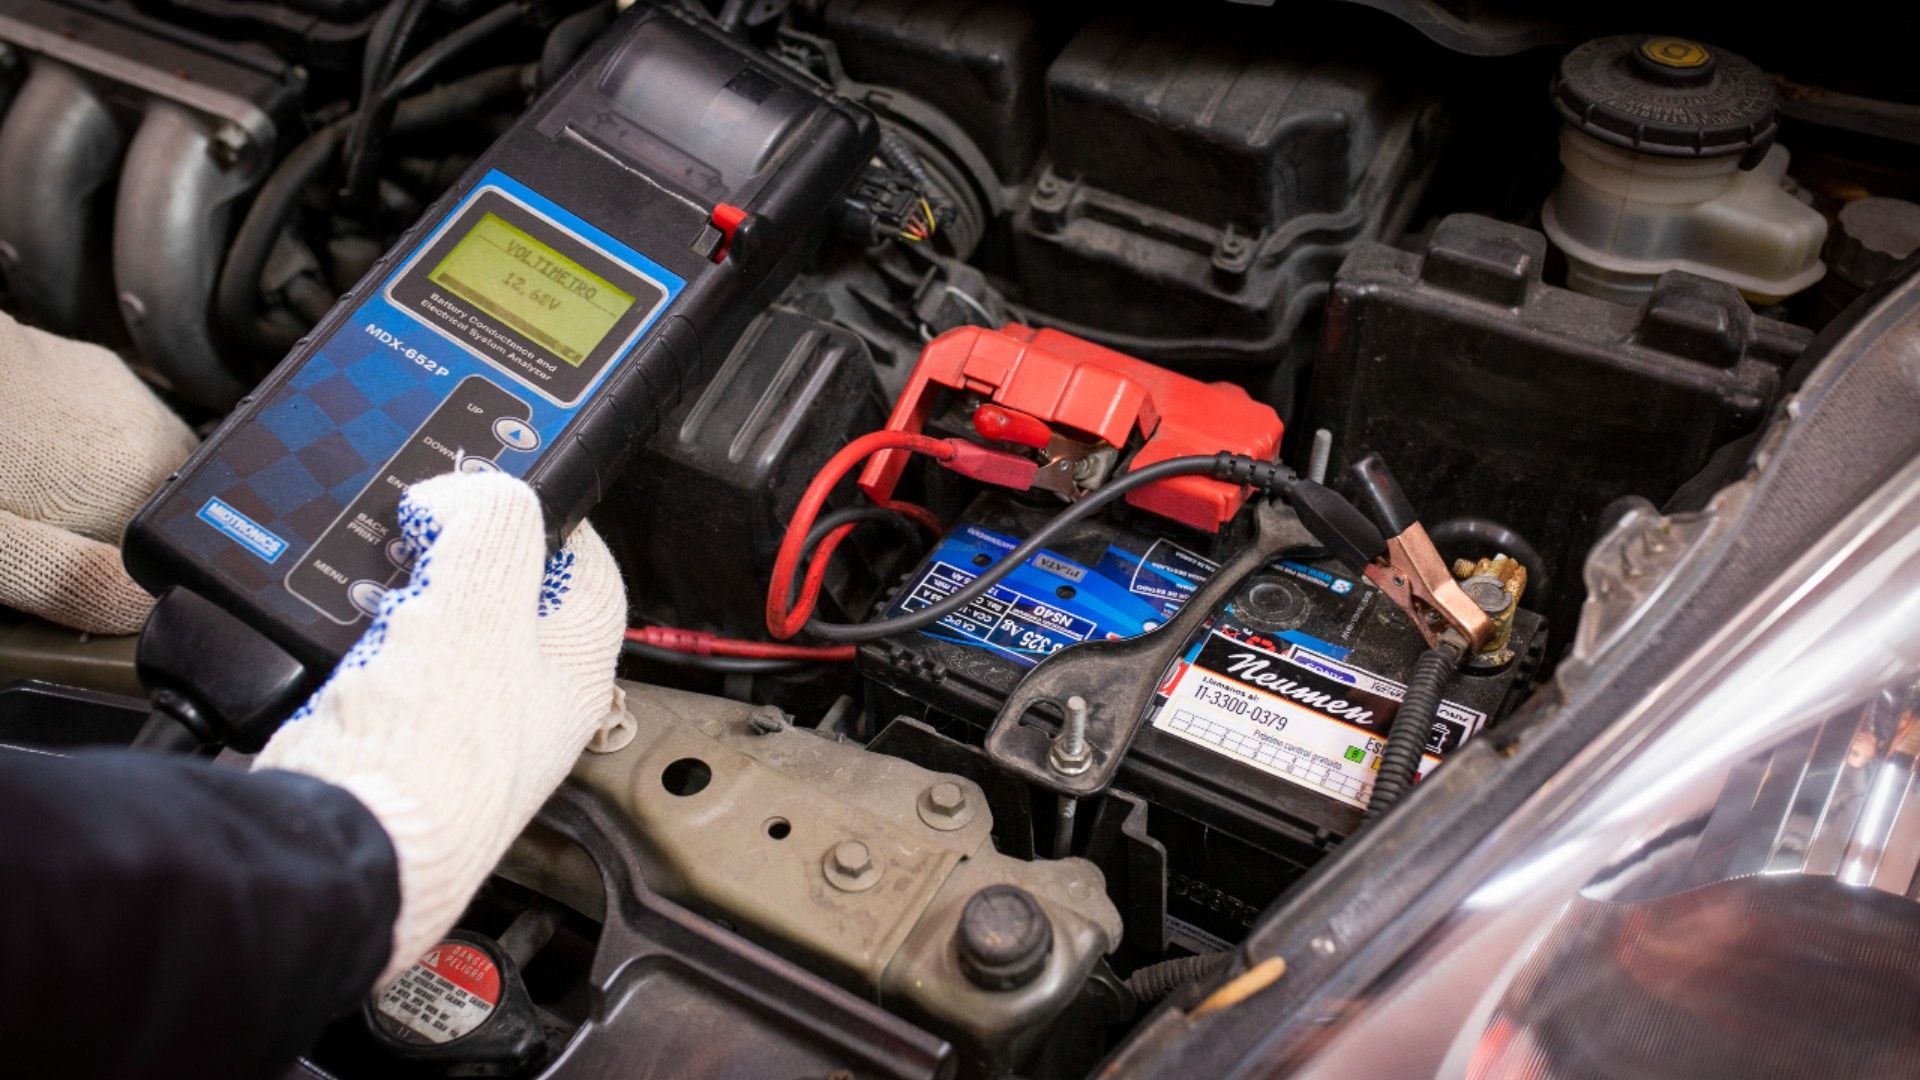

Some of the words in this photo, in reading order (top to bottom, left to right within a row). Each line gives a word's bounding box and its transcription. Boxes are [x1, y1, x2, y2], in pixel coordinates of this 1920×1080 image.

[505, 239, 598, 300] VOLTIMETRO
[420, 299, 469, 331] Electrical
[468, 328, 507, 355] System
[507, 352, 553, 381] Analyzer
[430, 292, 468, 319] Battery
[469, 315, 535, 360] Conductance
[536, 357, 557, 372] and
[466, 403, 484, 414] UP
[423, 436, 458, 461] DOWN
[386, 475, 410, 492] ENT
[207, 503, 281, 555] MIDTRONICS
[346, 521, 382, 545] PRINT
[356, 512, 389, 536] BACK
[312, 559, 349, 585] MENU
[1039, 556, 1084, 579] PLATA
[962, 621, 976, 632] CA
[973, 609, 993, 622] CCA
[1033, 605, 1074, 628] NS40
[1001, 619, 1025, 637] Ag
[1019, 631, 1052, 653] 325
[1227, 652, 1374, 725] Neumen
[1194, 684, 1288, 732] 11-3300-0379
[444, 954, 485, 981] PELIGRO
[452, 946, 494, 973] DANGER
